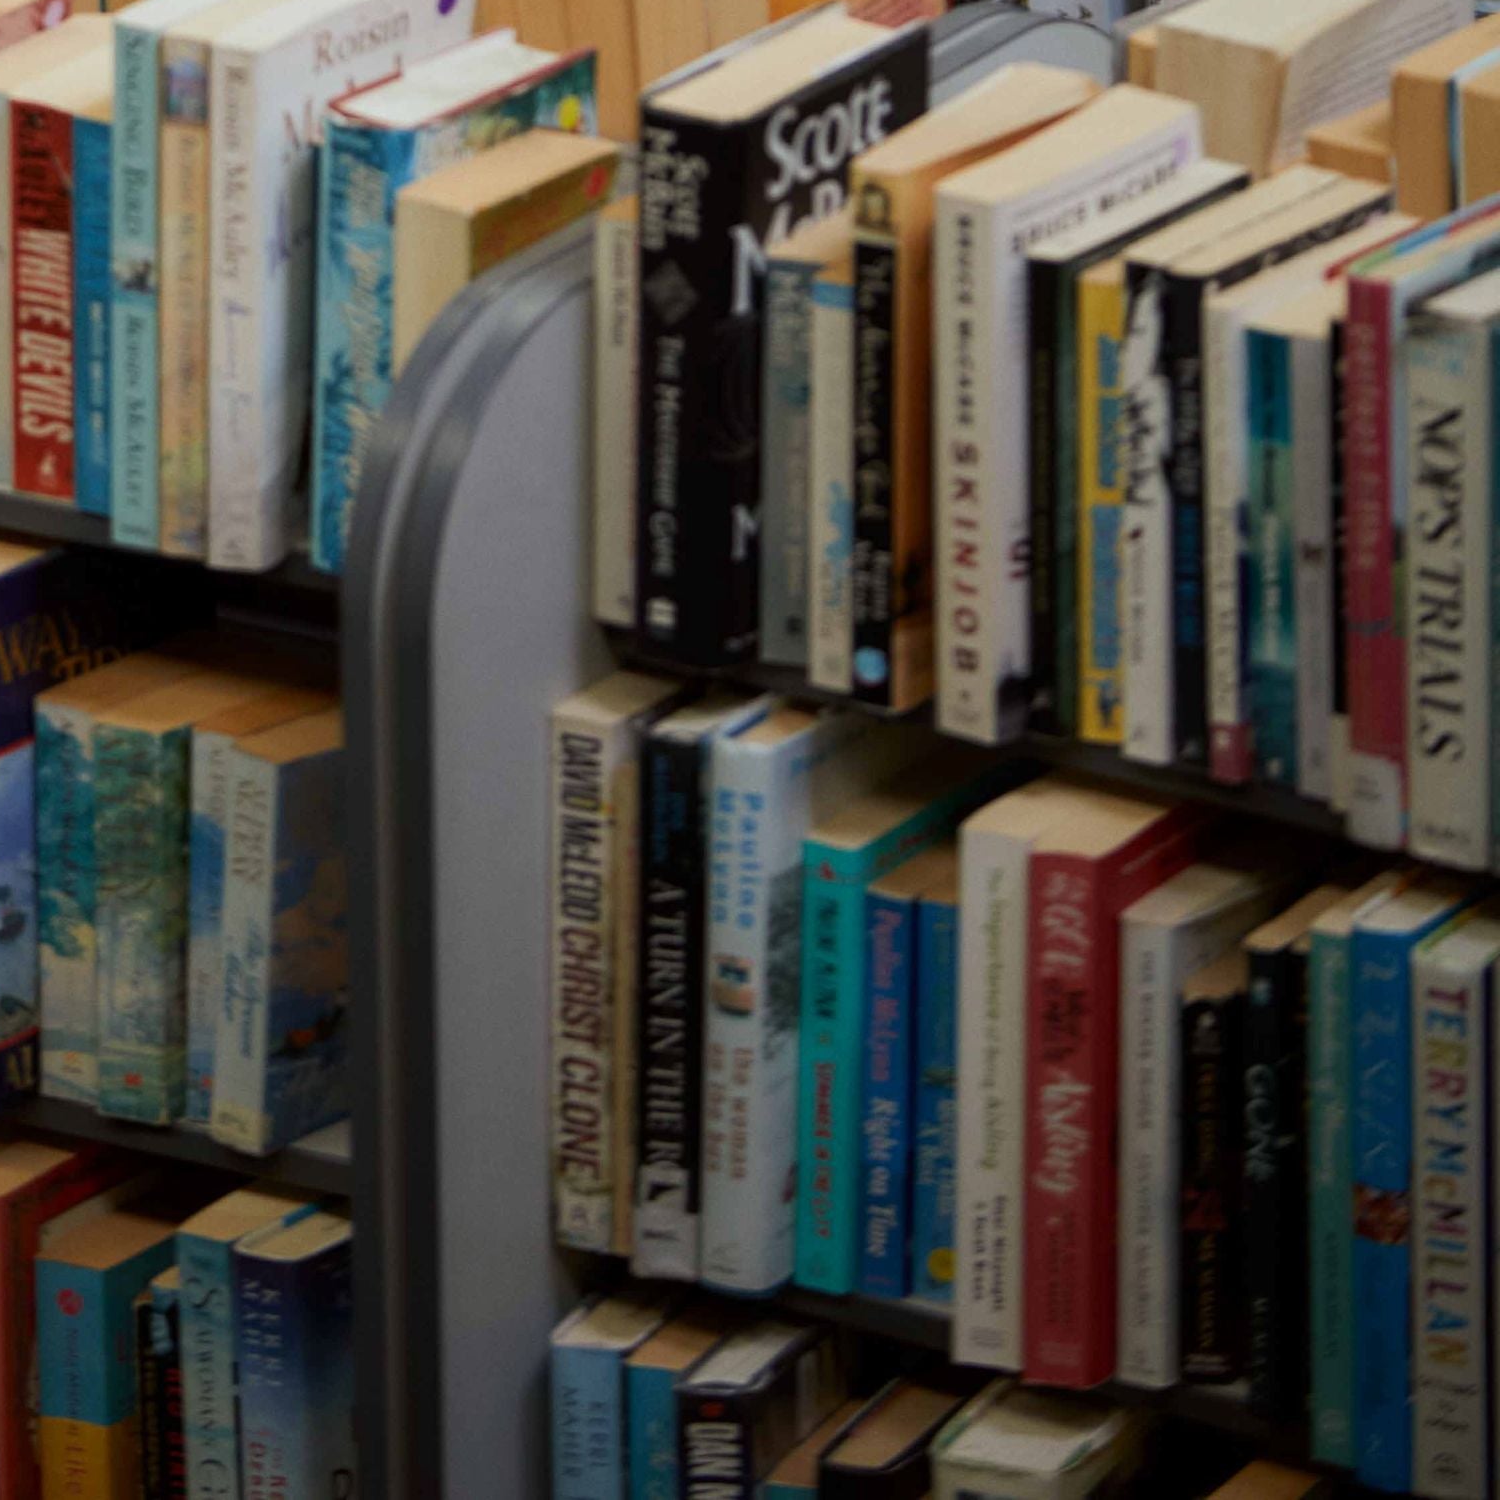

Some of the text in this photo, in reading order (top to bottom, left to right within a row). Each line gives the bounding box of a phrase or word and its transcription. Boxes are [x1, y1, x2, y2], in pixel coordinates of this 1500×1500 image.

[19, 228, 75, 444] WHITE DEVILS
[558, 732, 604, 1172] DAVID CHRIST CLONE
[648, 879, 689, 1132] A TURN IN THE
[864, 1097, 898, 1258] Right on Time
[1423, 986, 1469, 1368] TERRY McMILLAN
